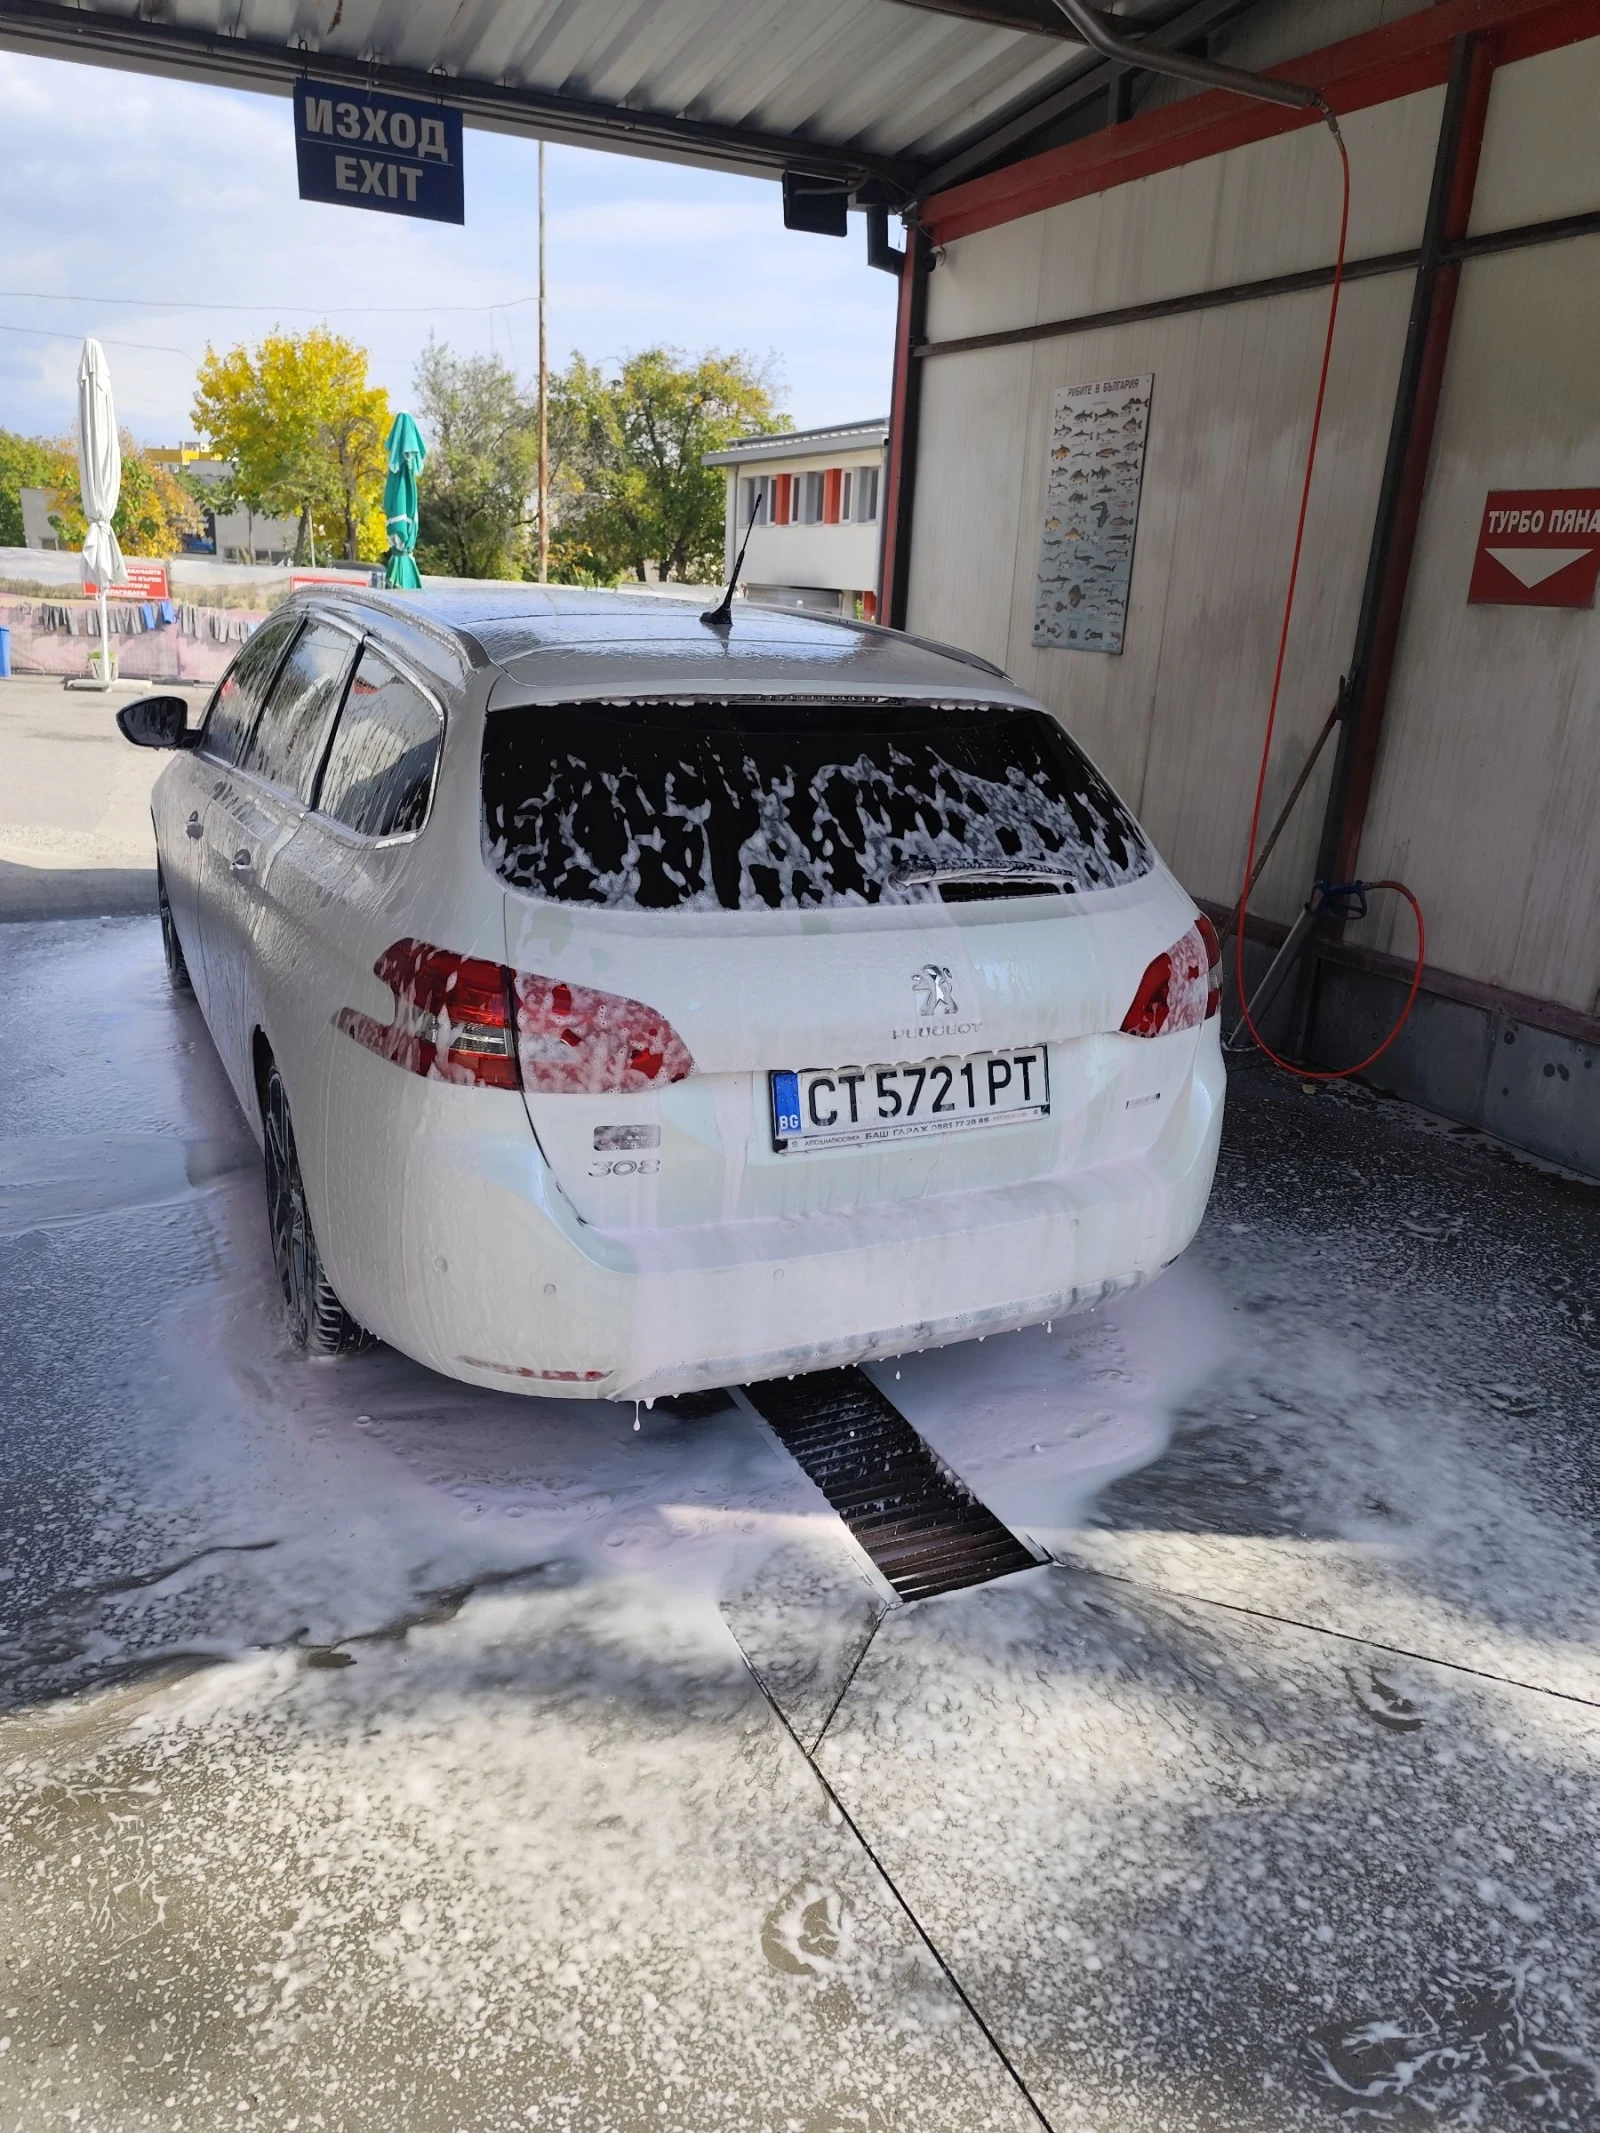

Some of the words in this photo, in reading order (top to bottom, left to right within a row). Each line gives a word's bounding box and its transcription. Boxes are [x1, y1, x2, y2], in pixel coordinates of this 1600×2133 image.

[305, 96, 448, 162] ИЗХОД
[335, 155, 423, 201] EXIT
[1067, 385, 1092, 397] РИБИТЕ
[1095, 384, 1100, 393] В
[1103, 379, 1139, 392] БЪЛГАРИЯ
[1488, 510, 1545, 533] ТУРБО
[1548, 509, 1600, 533] ПЯНА
[779, 1114, 799, 1131] BG
[865, 1130, 889, 1140] БАШ
[893, 1126, 928, 1137] ГАРАЖ
[955, 1120, 965, 1128] 77
[587, 1160, 661, 1177] 308
